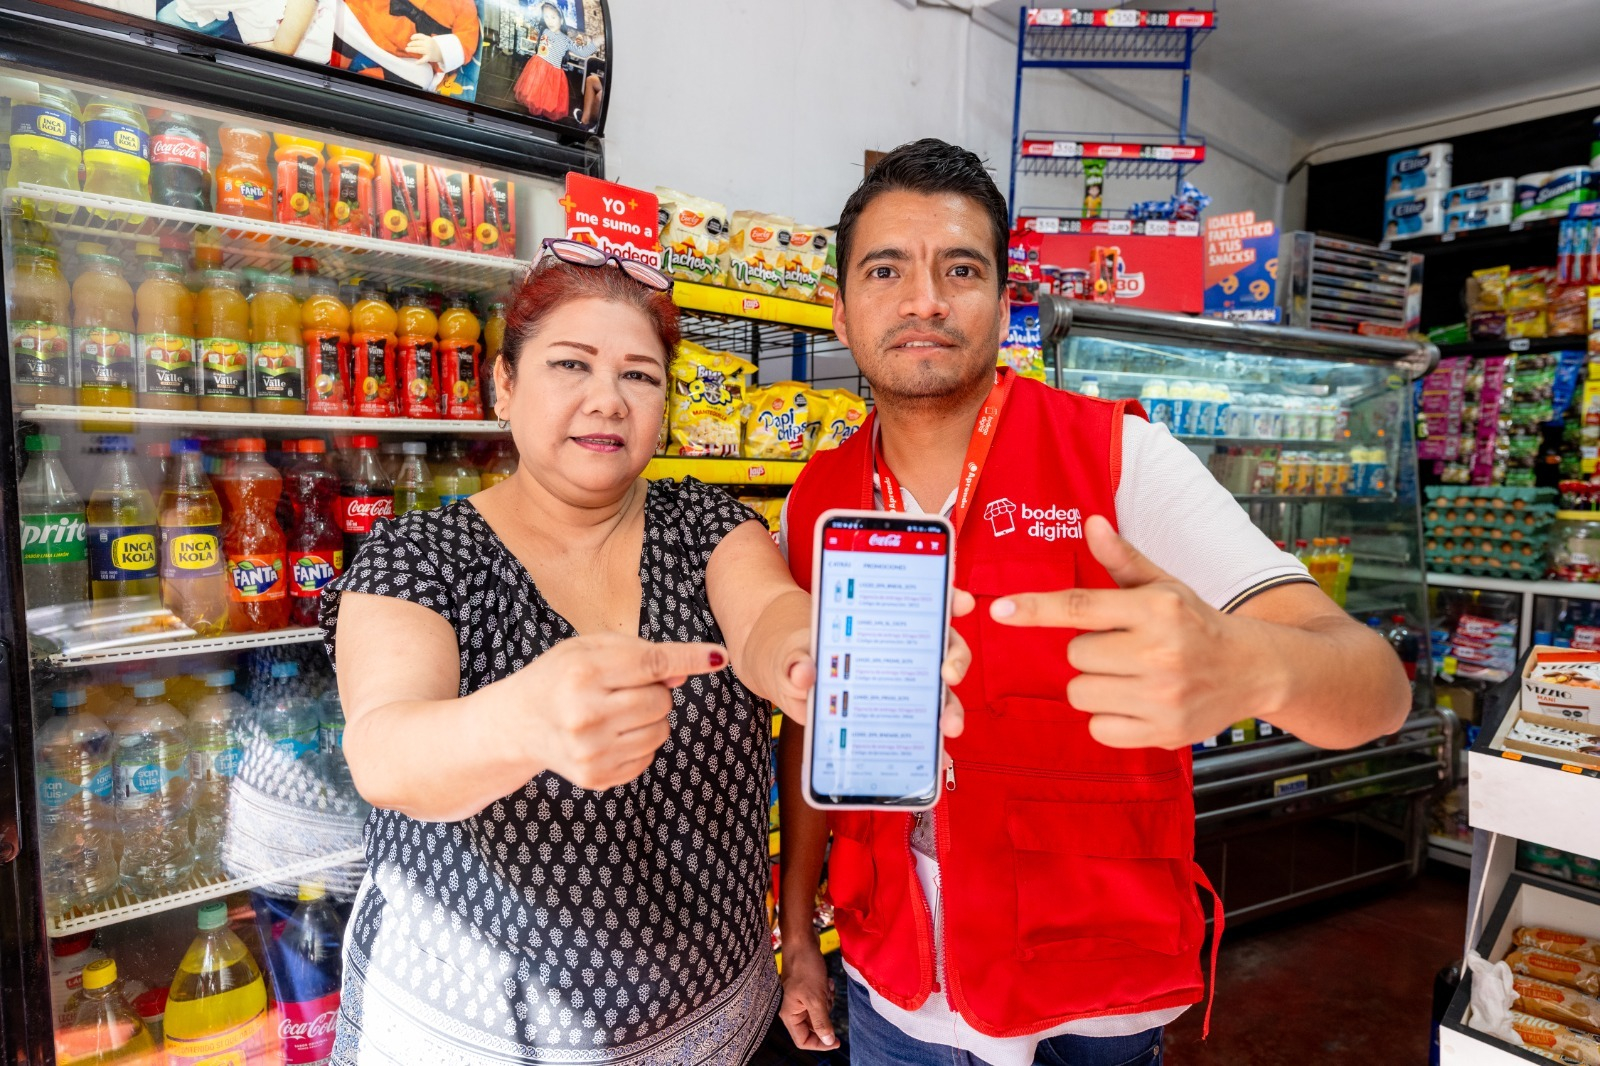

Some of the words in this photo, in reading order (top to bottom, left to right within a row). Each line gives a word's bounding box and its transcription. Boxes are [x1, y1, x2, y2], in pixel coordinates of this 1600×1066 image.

[42, 123, 62, 134] KOLA
[43, 117, 61, 128] INCA
[118, 139, 137, 149] KOLA
[120, 134, 136, 142] INCA
[154, 140, 197, 159] Coca-Cola
[1400, 156, 1428, 171] Elite
[240, 184, 264, 197] FANTA
[602, 196, 626, 215] YO
[576, 211, 599, 226] me
[602, 217, 641, 235] sumo
[643, 227, 653, 238] a
[1239, 211, 1255, 226] LO
[1208, 242, 1217, 254] A
[1218, 240, 1241, 253] TUS
[661, 246, 713, 274] Nachos
[1209, 249, 1256, 267] SNACKS!
[731, 259, 780, 285] Nachos
[27, 362, 57, 373] Valle
[92, 366, 119, 378] Valle
[156, 372, 183, 383] Valle
[214, 375, 239, 386] Valle
[263, 378, 287, 388] Valle
[692, 409, 728, 421] MANTEQUILLA
[758, 408, 794, 431] Papi
[777, 422, 807, 441] chips
[347, 499, 393, 517] Coca-Cola
[1021, 503, 1082, 524] bodega
[20, 517, 86, 550] prite
[1027, 520, 1083, 542] digital
[124, 541, 153, 552] INCA
[180, 540, 211, 552] INCA
[122, 553, 155, 563] KOLA
[179, 552, 214, 562] KOLA
[232, 566, 278, 587] FANTA
[293, 563, 335, 582] FANTA
[1526, 684, 1572, 700] VIZZIO
[220, 753, 238, 762] san
[138, 768, 159, 777] san
[43, 781, 63, 790] san
[138, 778, 158, 787] luis
